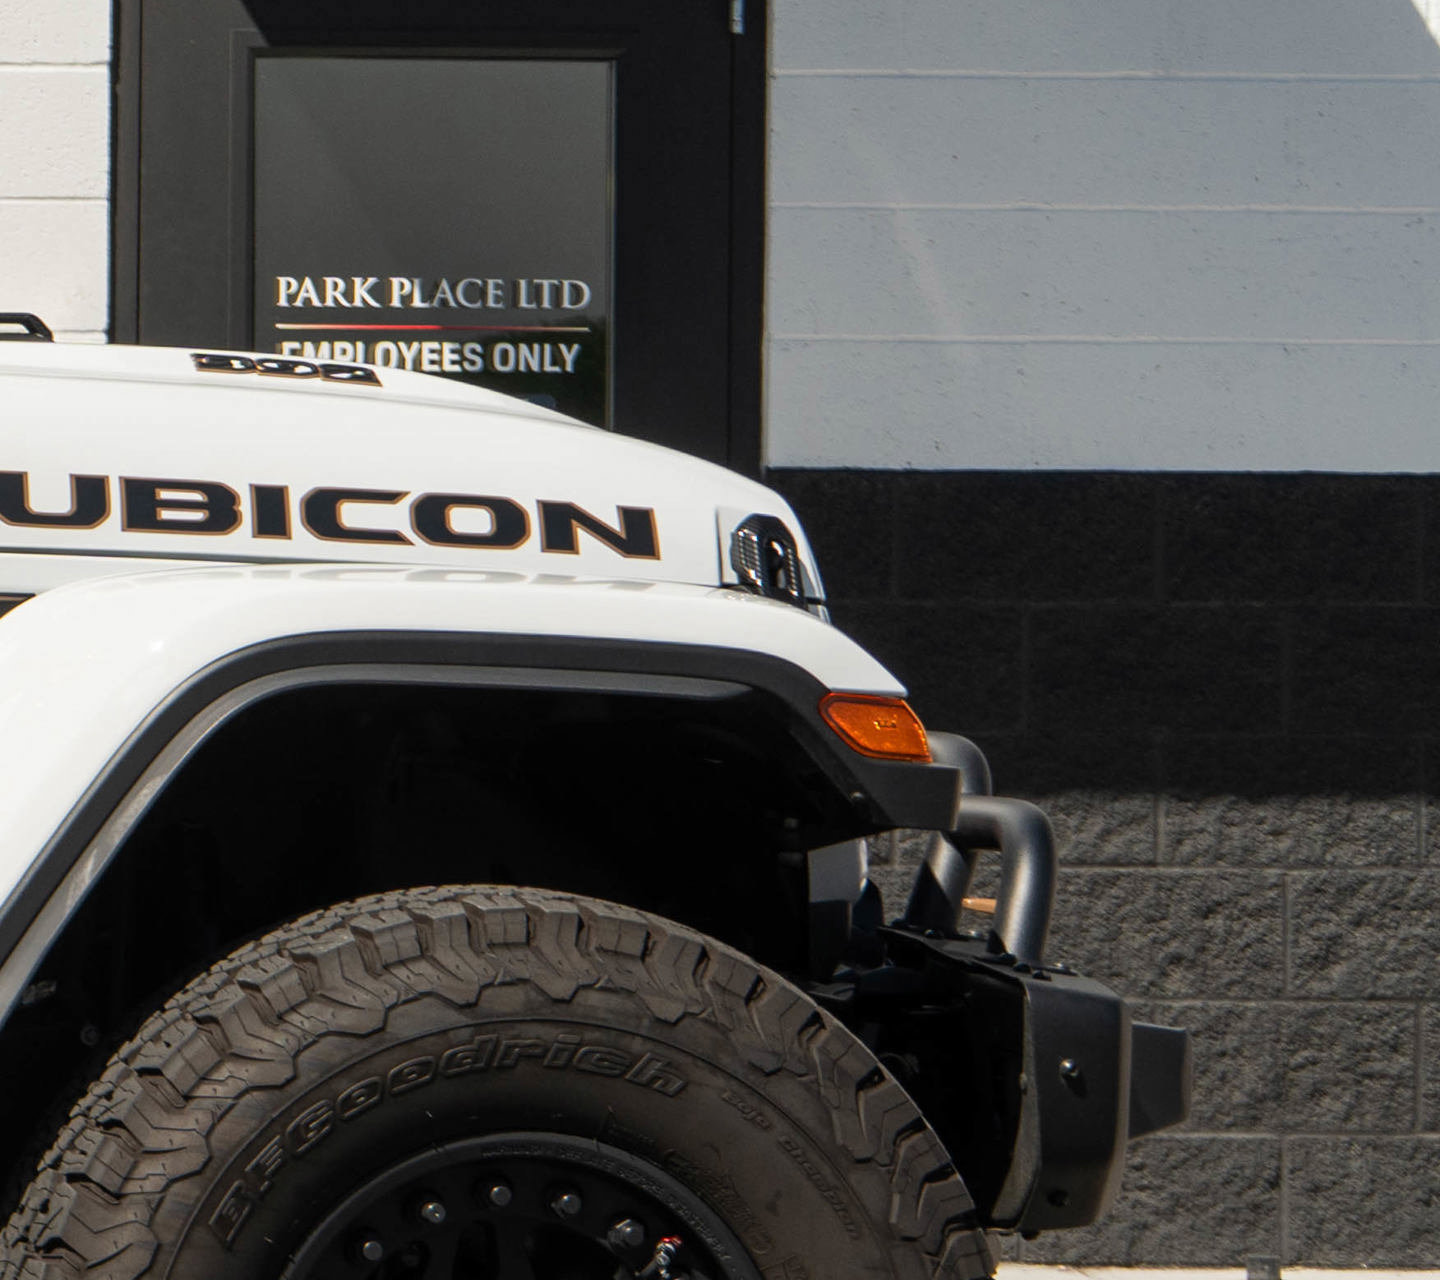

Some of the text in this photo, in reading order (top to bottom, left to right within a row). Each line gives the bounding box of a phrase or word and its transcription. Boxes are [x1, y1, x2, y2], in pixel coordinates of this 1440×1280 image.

[276, 276, 591, 310] PARK PLACE LTD
[493, 343, 580, 373] ONLY
[208, 1034, 686, 1252] BFGoodrich
